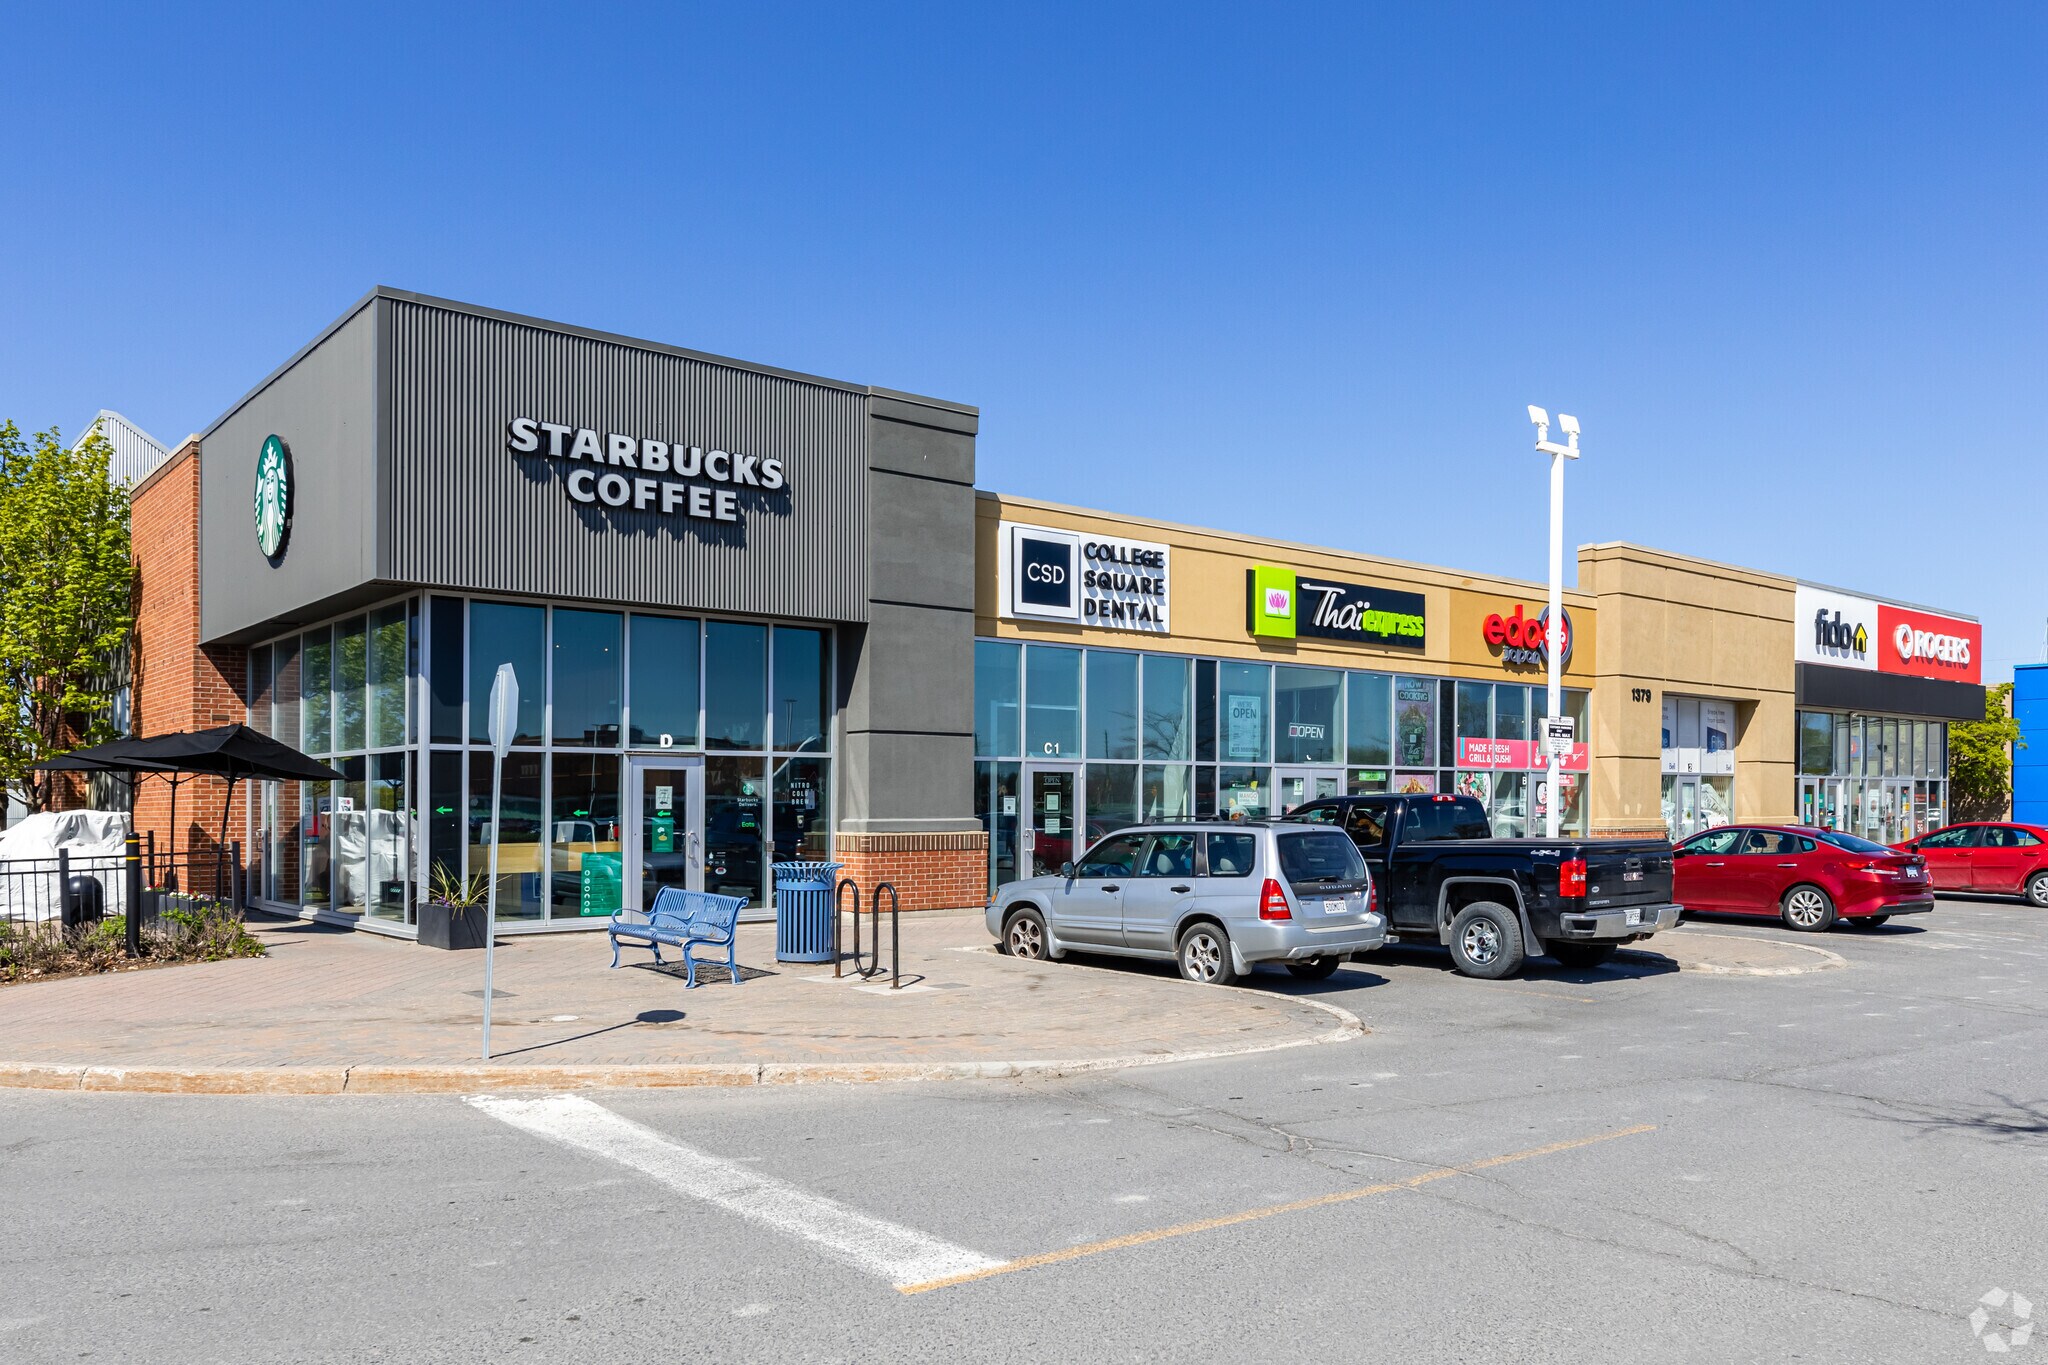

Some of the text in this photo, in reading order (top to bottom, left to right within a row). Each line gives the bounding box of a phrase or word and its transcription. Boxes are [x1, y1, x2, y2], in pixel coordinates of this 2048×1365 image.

[508, 416, 783, 489] STARBUCKS
[565, 469, 737, 521] COFFEE
[1084, 542, 1164, 569] COLLEGE
[1027, 562, 1065, 584] CSD
[1084, 570, 1164, 595] SQUARE
[1084, 598, 1164, 622] DENTAL
[1362, 609, 1424, 638] express
[1483, 604, 1541, 649] edo
[1815, 608, 1852, 650] fido
[1914, 630, 1970, 664] ROGERS
[1404, 680, 1422, 689] NOW
[1399, 691, 1428, 700] COOKING
[1632, 688, 1651, 703] 1379
[1233, 708, 1257, 719] OPEN
[660, 734, 673, 748] D
[1298, 726, 1325, 738] OPEN
[1044, 742, 1059, 754] C1
[1468, 743, 1510, 754] MADE FRESH
[1468, 753, 1487, 763] GRILL
[1494, 754, 1512, 764] SUSHI
[1522, 776, 1527, 785] B
